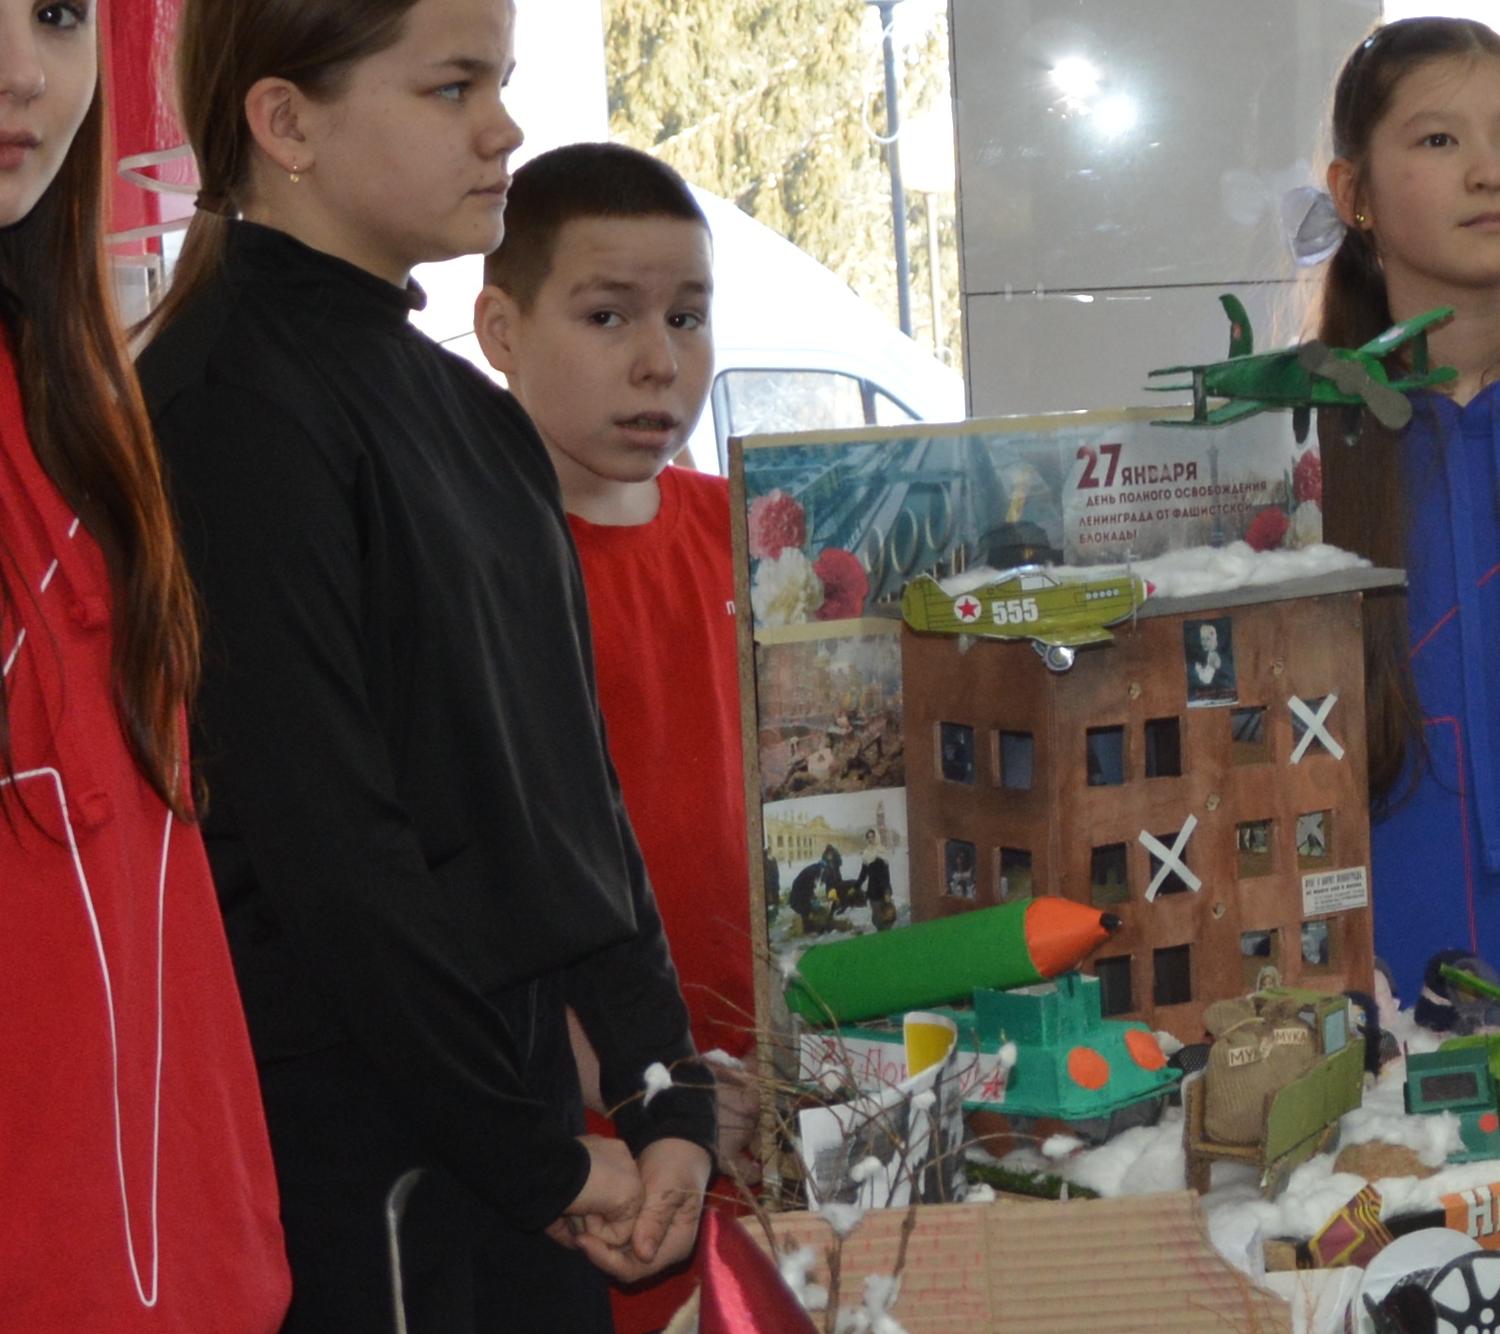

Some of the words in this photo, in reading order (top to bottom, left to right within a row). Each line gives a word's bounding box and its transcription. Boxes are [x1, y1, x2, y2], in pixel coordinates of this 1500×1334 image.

[1076, 443, 1122, 490] 27
[1121, 461, 1198, 487] ЯНВАРЯ
[1086, 493, 1117, 508] ДЕНЬ
[1119, 488, 1173, 504] ПОЛНОГО
[1174, 480, 1268, 500] ОСВОБОЖДЕНИЯ
[1078, 512, 1154, 528] ЛЕНИНГРАДА
[1156, 509, 1170, 521] ОТ
[1078, 529, 1138, 545] БЛОКАДЫ
[991, 597, 1039, 626] 555
[1275, 1031, 1307, 1045] МУКА
